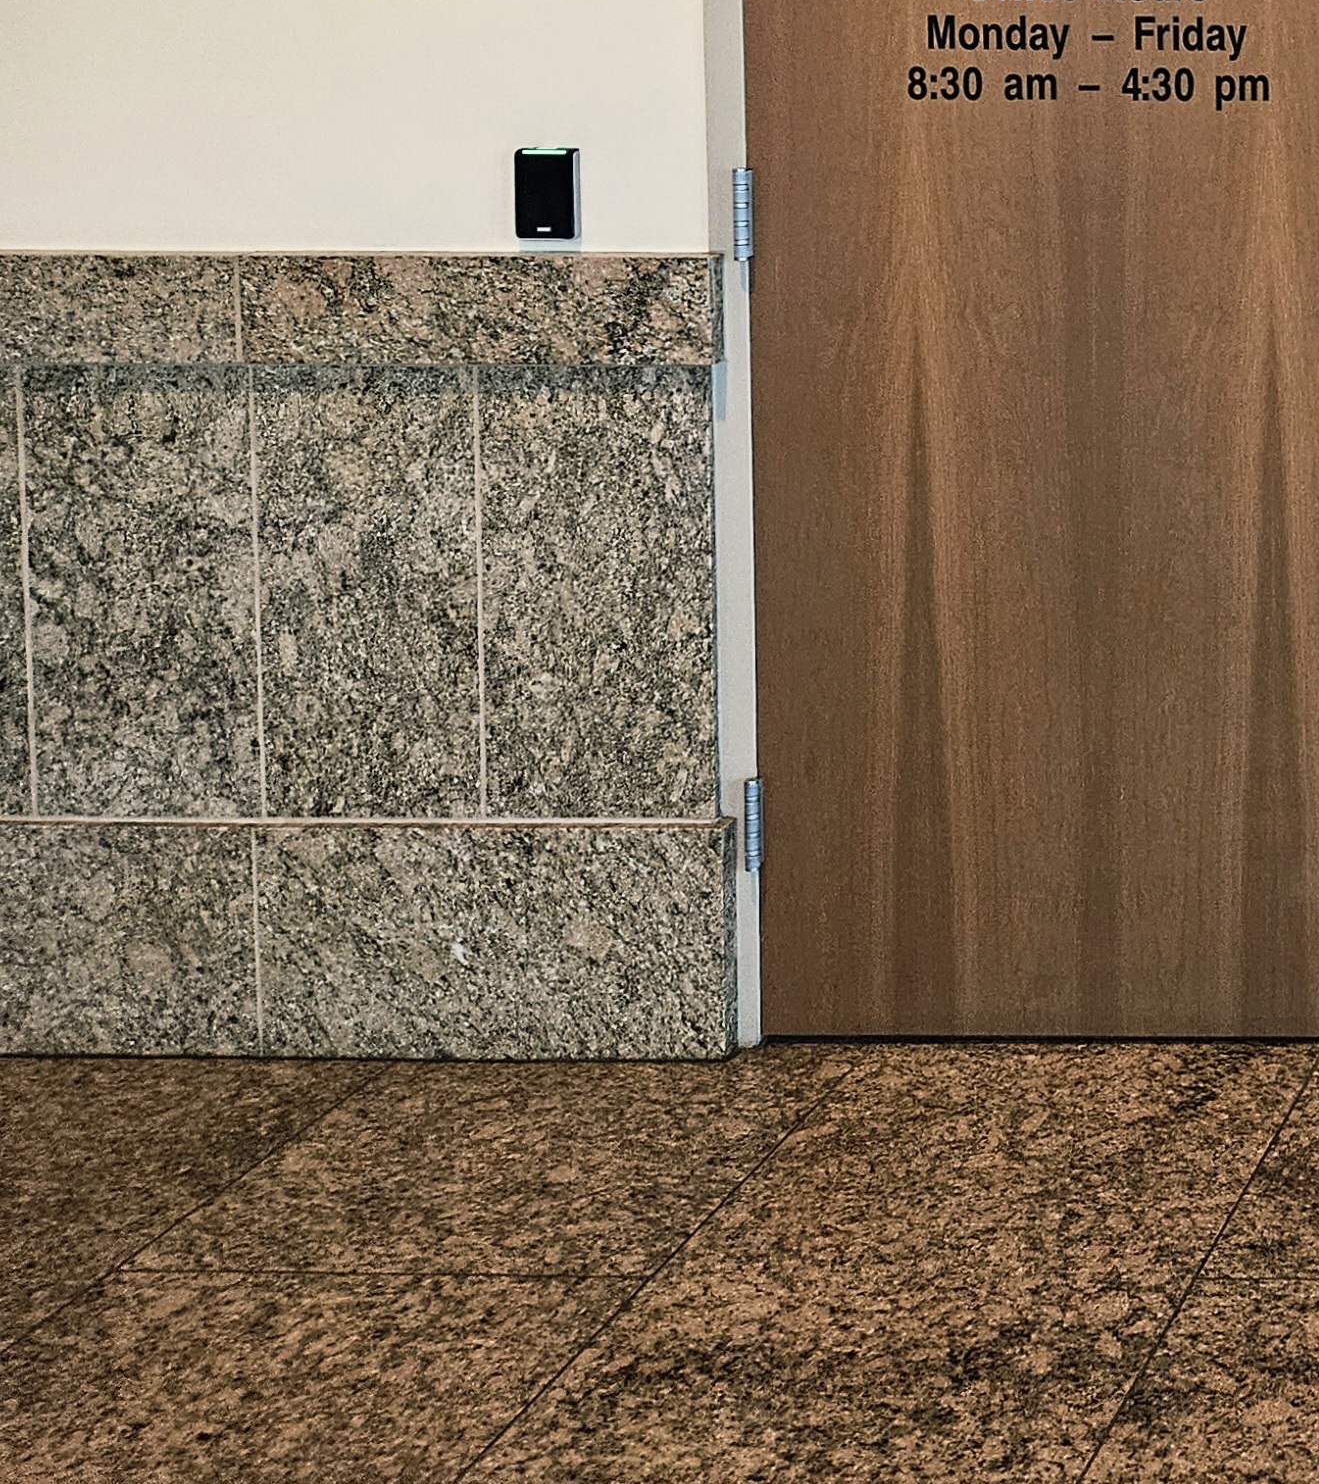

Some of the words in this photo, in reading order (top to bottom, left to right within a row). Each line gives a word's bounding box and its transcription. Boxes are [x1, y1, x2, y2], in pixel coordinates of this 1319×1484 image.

[927, 14, 1070, 60] Monday
[1135, 16, 1247, 61] Friday
[907, 66, 983, 101] 8:30
[1005, 73, 1057, 101] am
[1121, 67, 1195, 102] 4:30
[1215, 74, 1270, 112] pm
